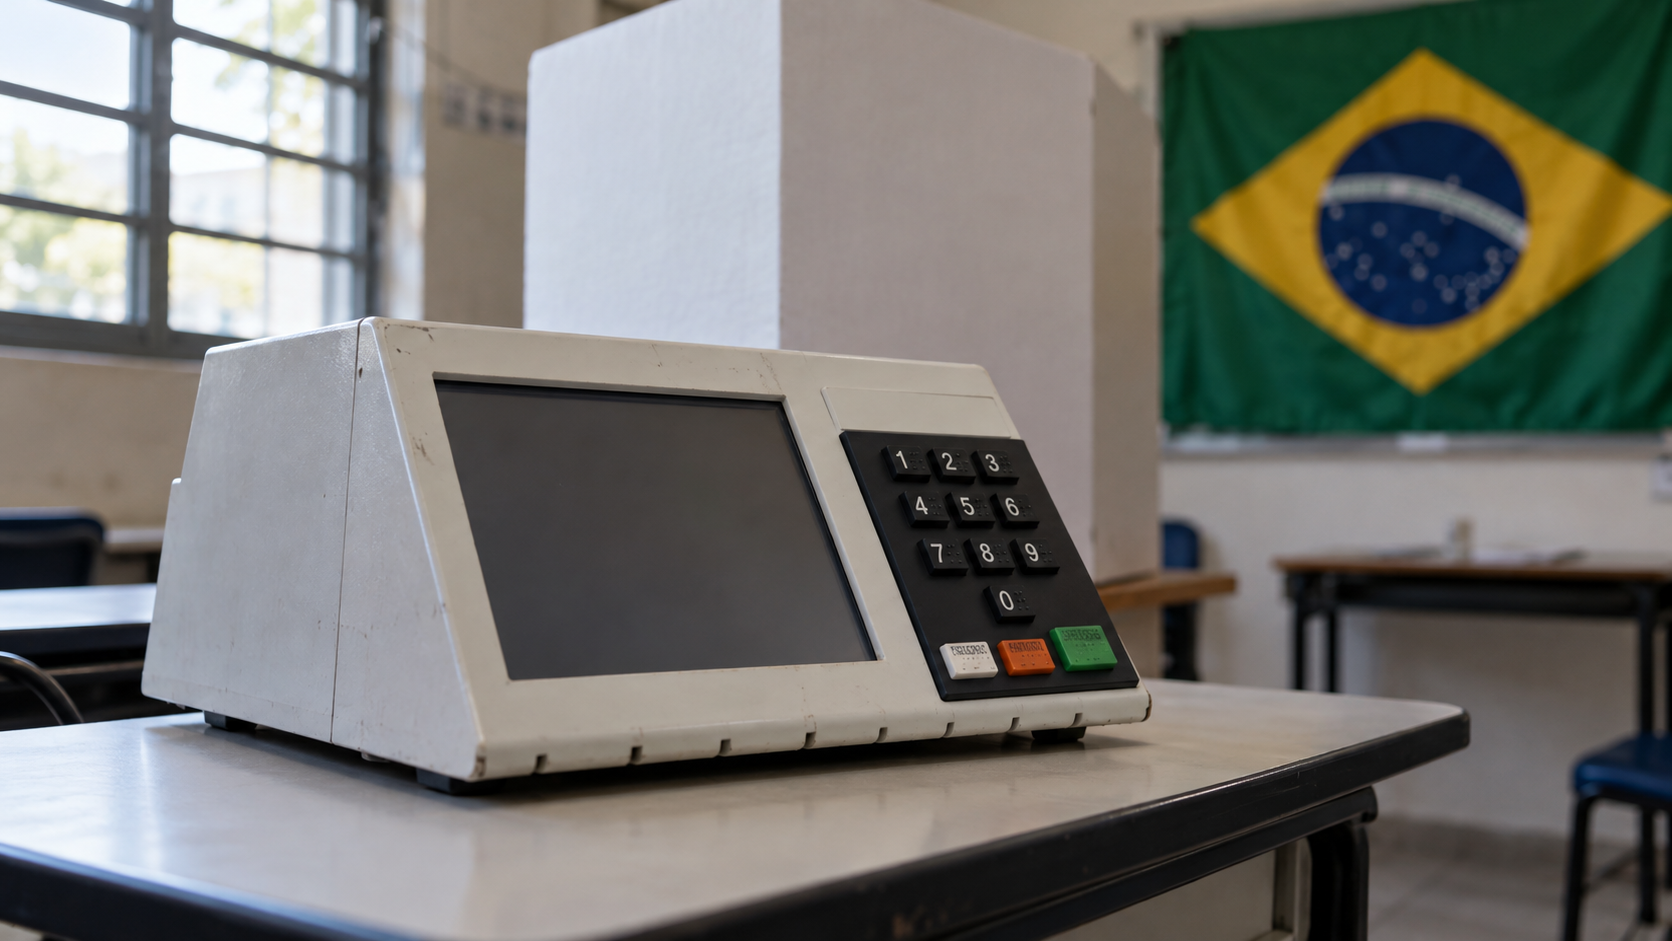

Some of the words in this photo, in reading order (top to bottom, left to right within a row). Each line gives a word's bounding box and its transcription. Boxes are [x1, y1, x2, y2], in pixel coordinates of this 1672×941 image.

[895, 450, 909, 469] 1
[941, 452, 957, 471] 2
[985, 453, 1000, 472] 3
[915, 495, 929, 515] 4
[960, 496, 975, 516] 5
[1004, 497, 1020, 516] 6
[930, 543, 943, 564] 7
[979, 542, 995, 563] 8
[1024, 542, 1039, 562] 9
[999, 590, 1014, 611] 0
